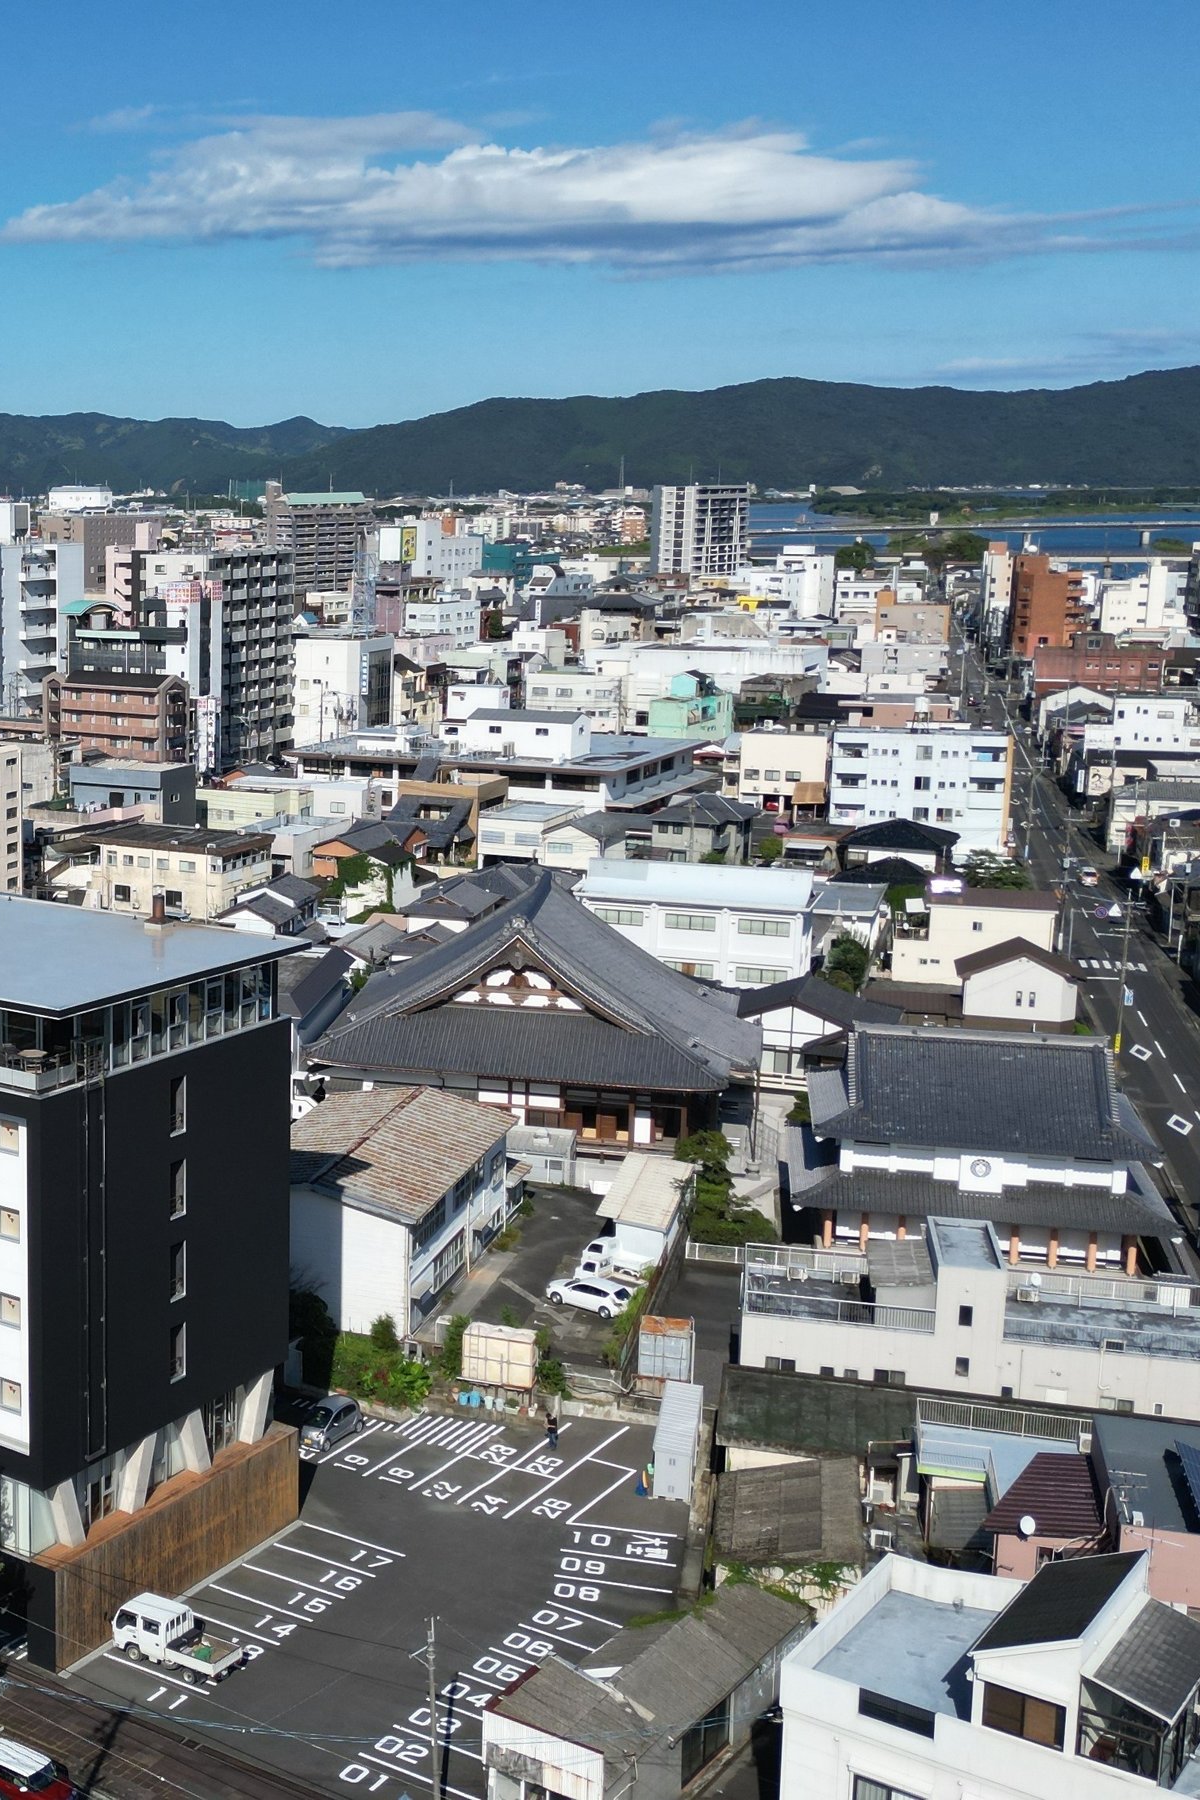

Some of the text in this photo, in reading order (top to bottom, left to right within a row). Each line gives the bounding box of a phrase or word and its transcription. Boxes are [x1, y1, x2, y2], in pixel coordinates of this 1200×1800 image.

[333, 1454, 370, 1471] 19
[525, 1455, 564, 1474] 25
[378, 1467, 414, 1484] 18
[471, 1494, 508, 1515] 24
[531, 1498, 572, 1519] 26
[573, 1531, 612, 1546] 10
[350, 1550, 394, 1568] 17
[560, 1557, 605, 1575] 09
[319, 1569, 363, 1591] 16
[288, 1592, 333, 1613] 15
[553, 1583, 600, 1601] 08
[254, 1615, 298, 1638] 14
[532, 1609, 583, 1631] 07
[502, 1632, 554, 1657] 06
[472, 1656, 526, 1681] 05
[146, 1686, 188, 1710] 11
[441, 1681, 493, 1708] 04
[408, 1707, 462, 1734] 03
[373, 1735, 429, 1765] 02
[338, 1764, 390, 1792] 01
